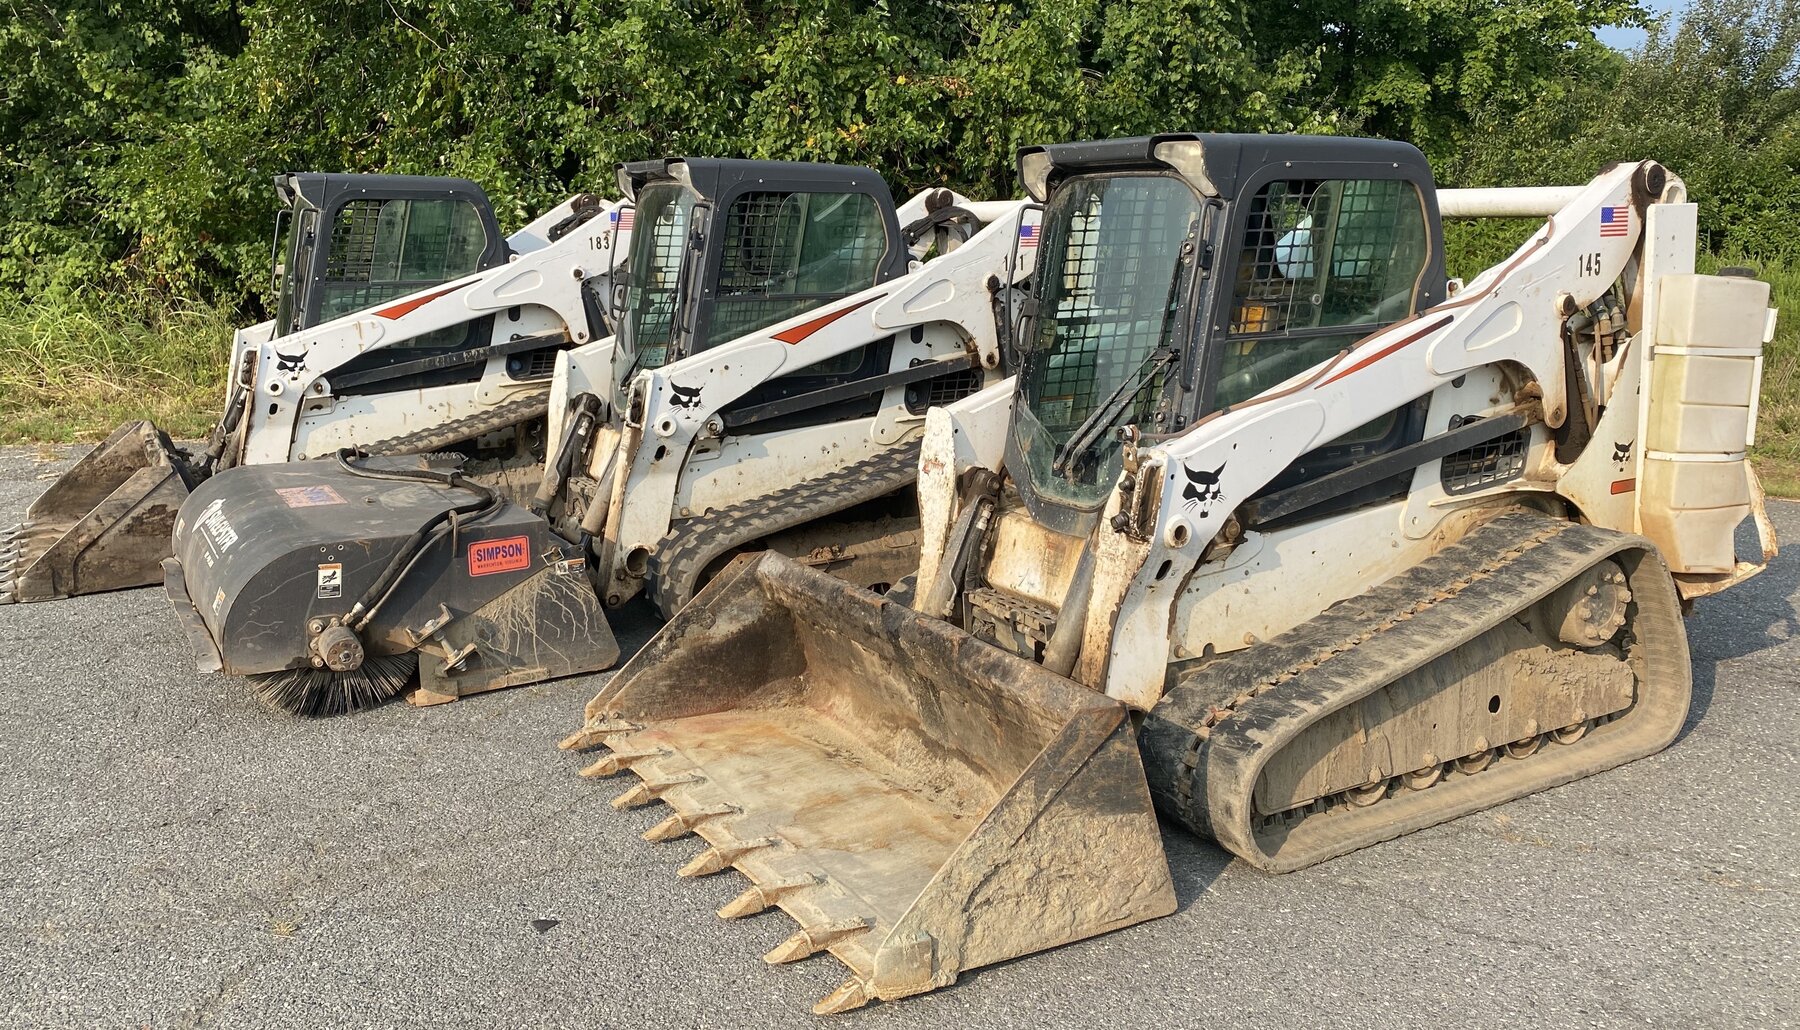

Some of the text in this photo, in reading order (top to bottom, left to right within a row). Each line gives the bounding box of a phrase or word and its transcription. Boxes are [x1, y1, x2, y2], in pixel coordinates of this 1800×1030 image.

[589, 236, 610, 250] 183
[1004, 254, 1024, 271] 11
[1579, 252, 1601, 278] 145
[476, 543, 522, 562] SIMPSON
